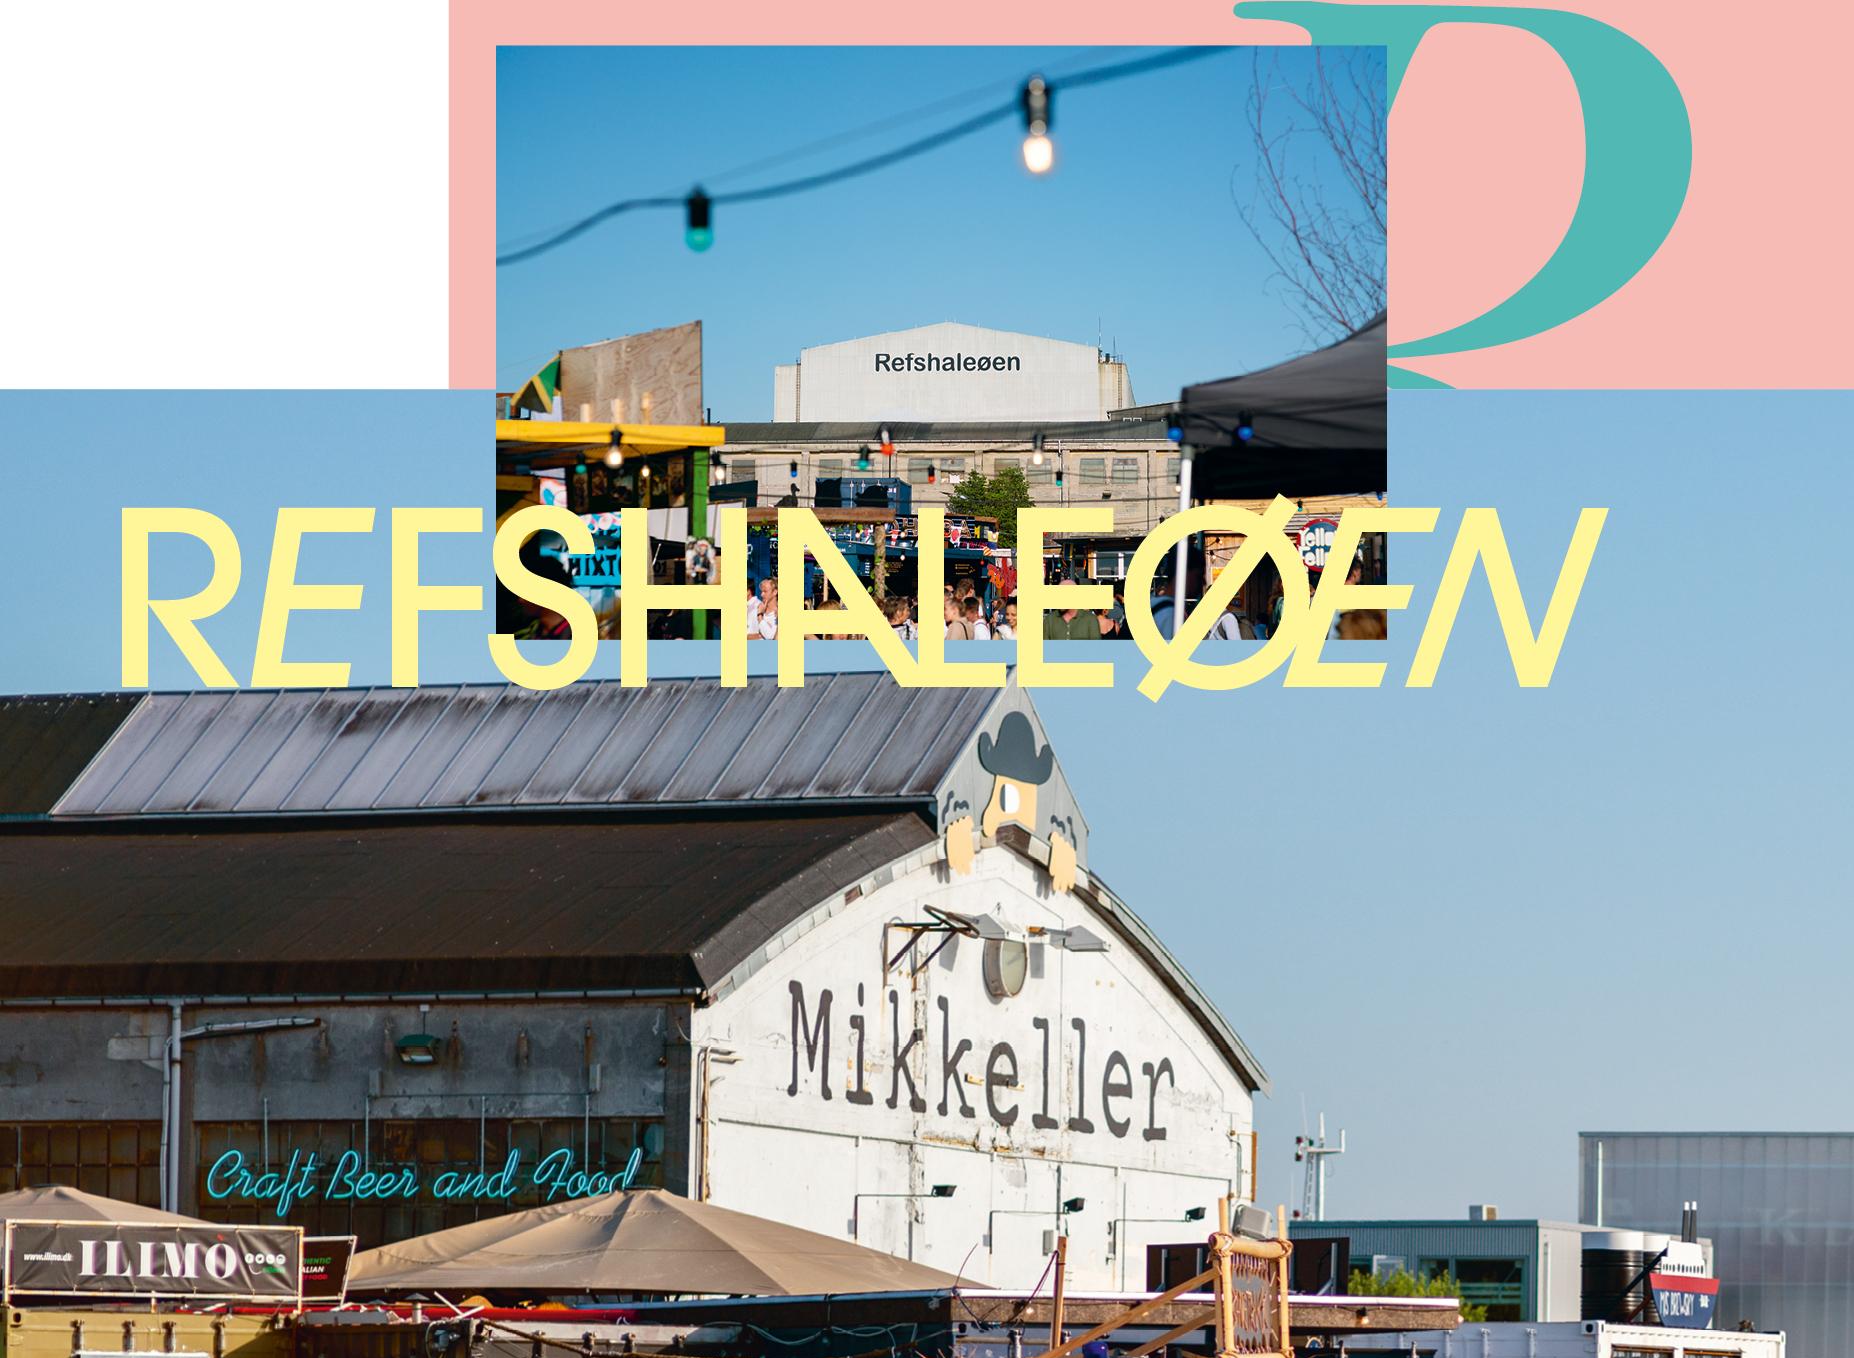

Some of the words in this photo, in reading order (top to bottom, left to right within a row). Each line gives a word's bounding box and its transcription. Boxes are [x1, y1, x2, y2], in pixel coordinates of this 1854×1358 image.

[875, 353, 1021, 372] Refshaleøen
[568, 554, 622, 576] MIXT
[788, 980, 1175, 1142] Mikkeller
[207, 1147, 317, 1218] Craft
[325, 1149, 421, 1201] Beer
[433, 1147, 519, 1200] and
[533, 1147, 644, 1202] Food
